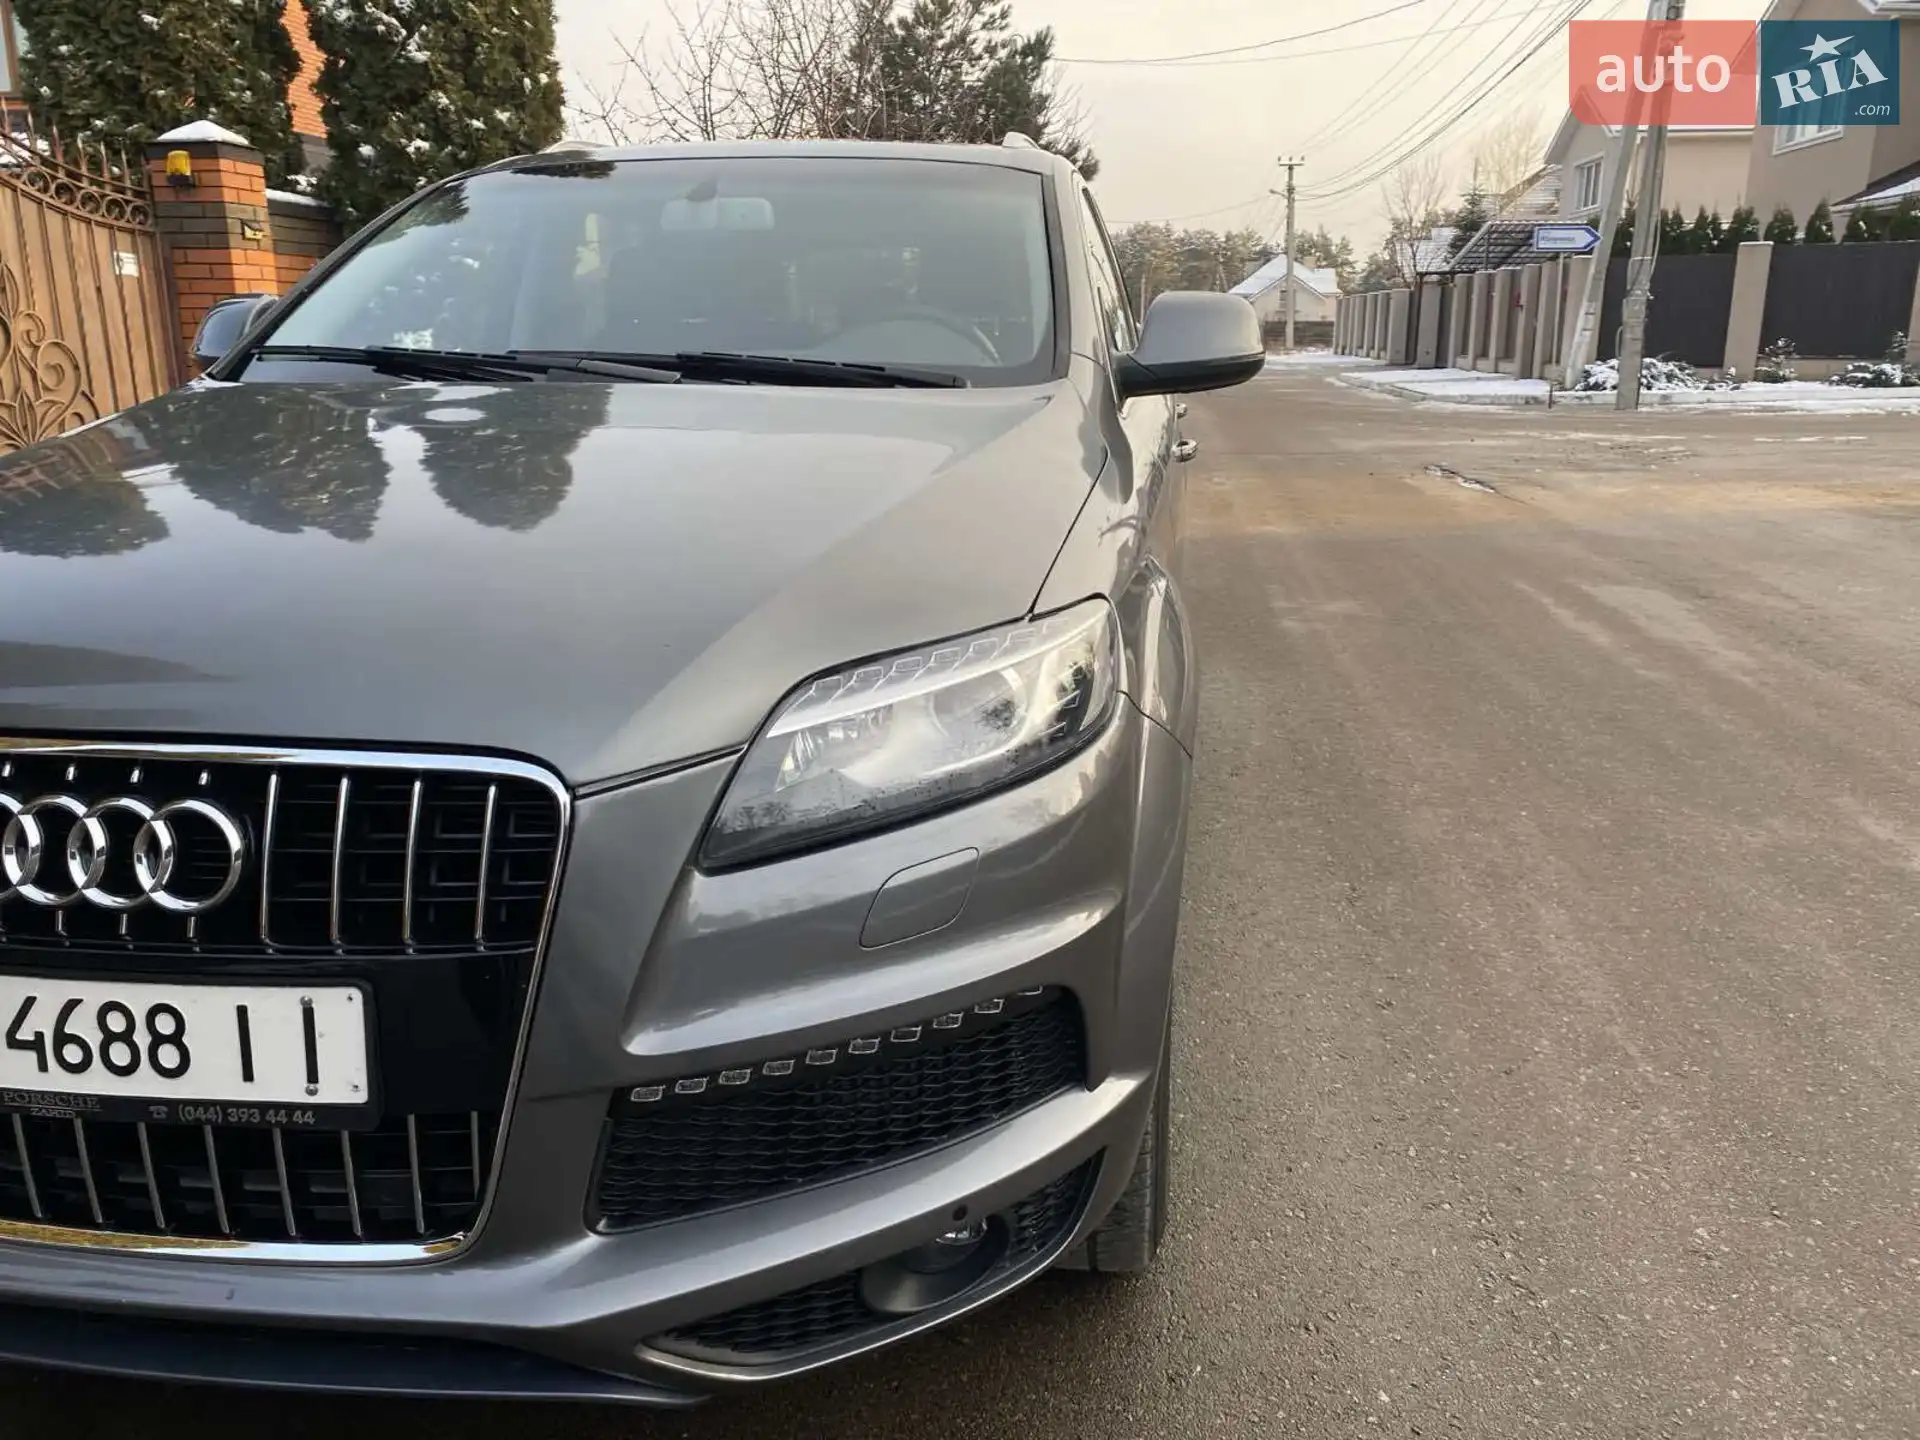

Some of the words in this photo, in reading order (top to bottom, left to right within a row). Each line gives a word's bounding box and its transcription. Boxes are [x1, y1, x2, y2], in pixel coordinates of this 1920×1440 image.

[5, 995, 191, 1079] 4688
[227, 1108, 260, 1123] 393
[265, 1109, 288, 1124] 44
[292, 1110, 316, 1125] 44
